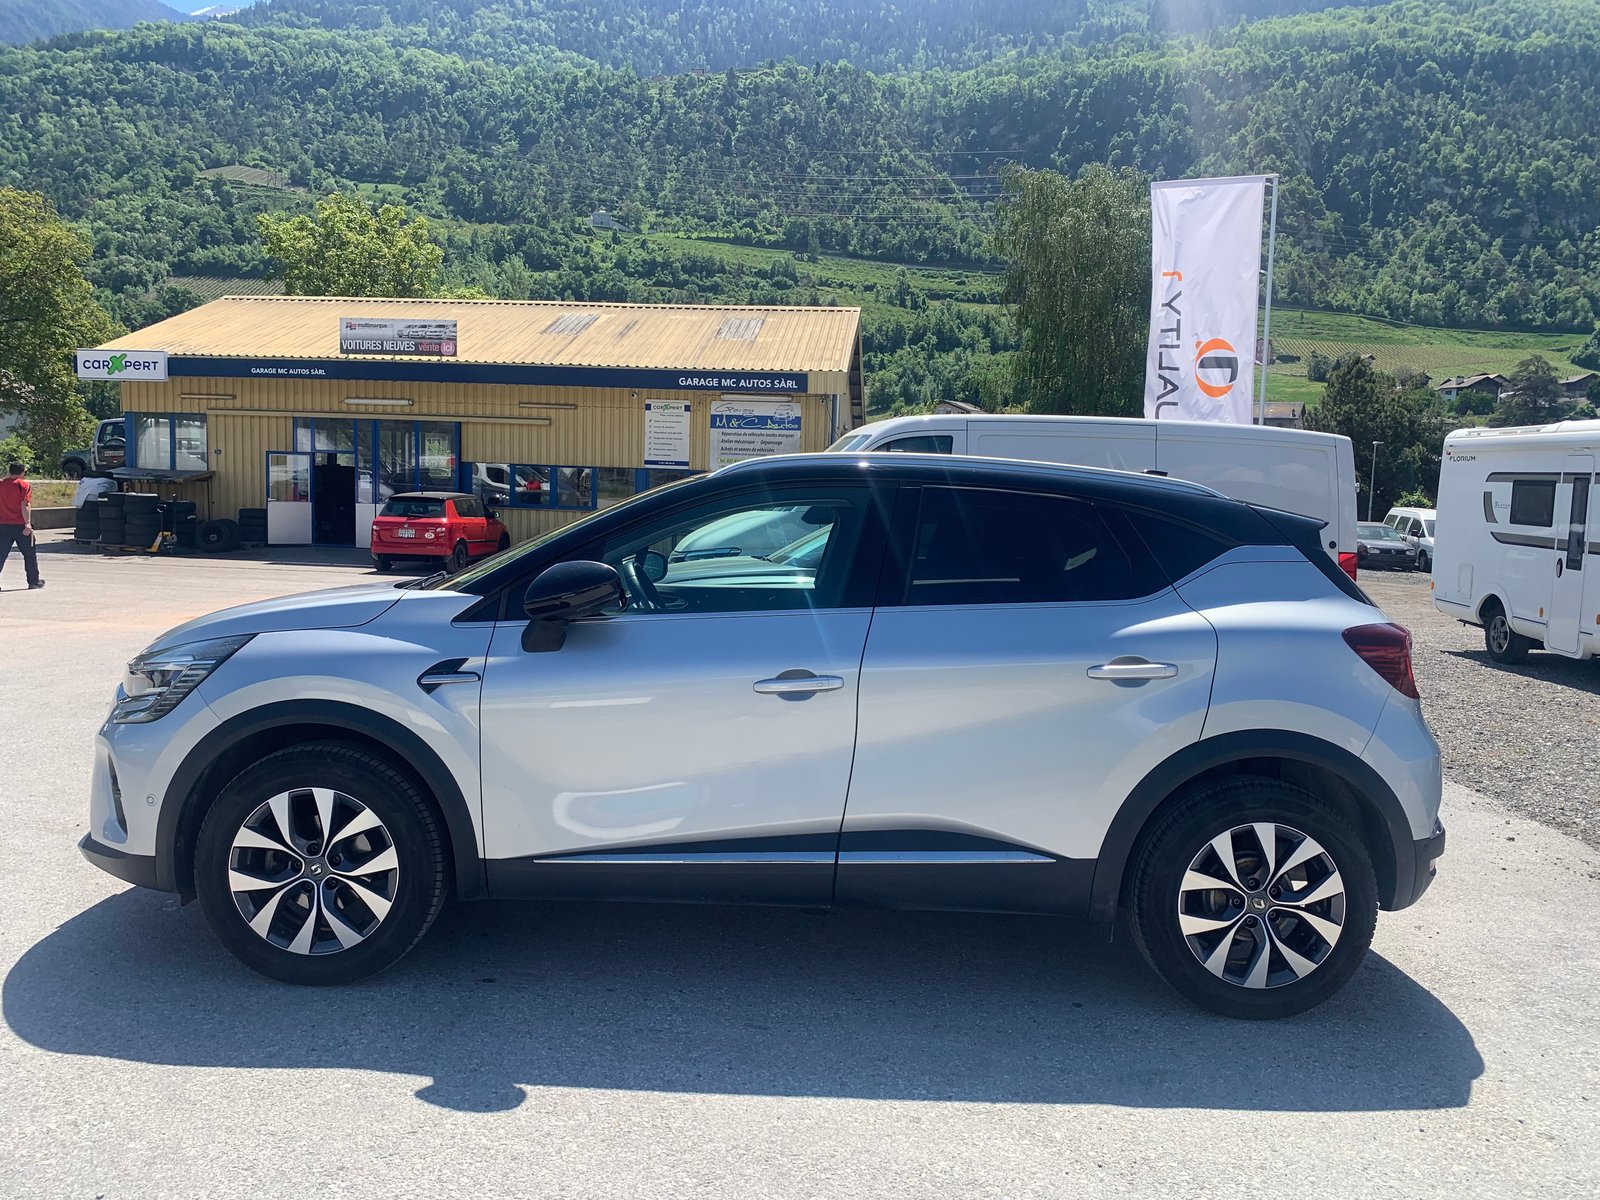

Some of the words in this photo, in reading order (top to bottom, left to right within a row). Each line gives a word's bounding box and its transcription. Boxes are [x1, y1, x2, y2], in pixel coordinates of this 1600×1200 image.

[342, 340, 382, 351] VOITURES
[383, 341, 416, 352] NEUVES
[678, 377, 719, 387] GARAGE
[721, 378, 737, 387] MC
[739, 379, 772, 388] AUTOS
